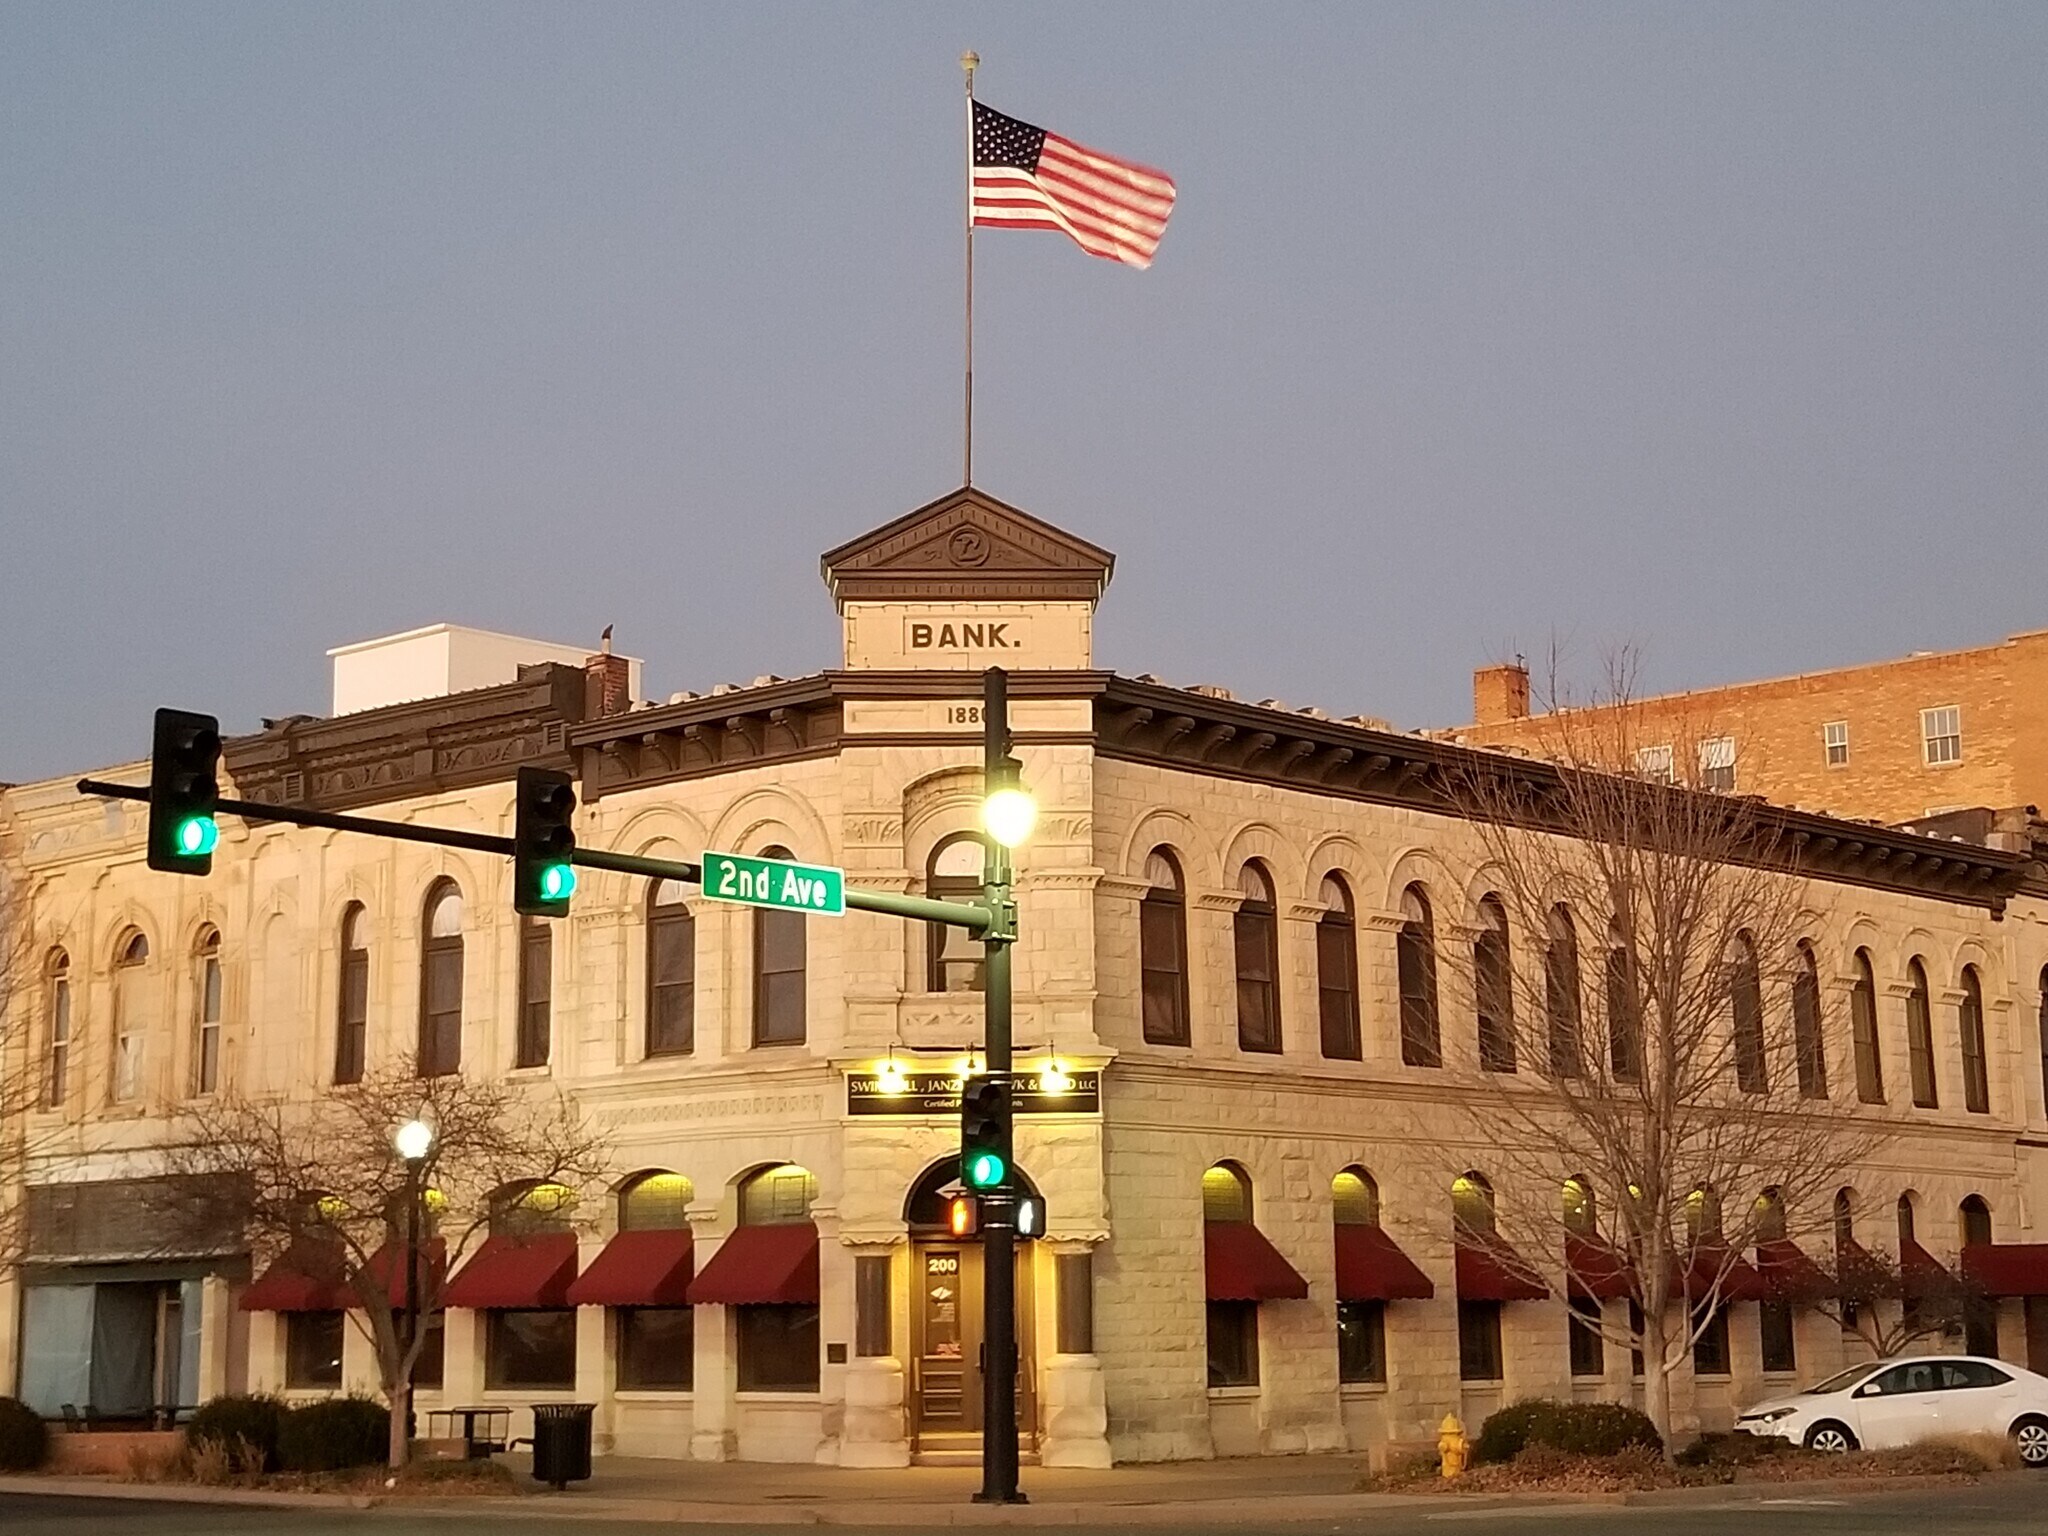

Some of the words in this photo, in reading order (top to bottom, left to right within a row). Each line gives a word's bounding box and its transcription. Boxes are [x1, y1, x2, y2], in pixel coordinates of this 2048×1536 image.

[911, 623, 1021, 648] BANK.
[718, 860, 770, 900] 2nd
[781, 868, 827, 907] Ave
[1027, 1079, 1038, 1090] &
[1079, 1080, 1096, 1090] LLC
[928, 1258, 957, 1272] 200
